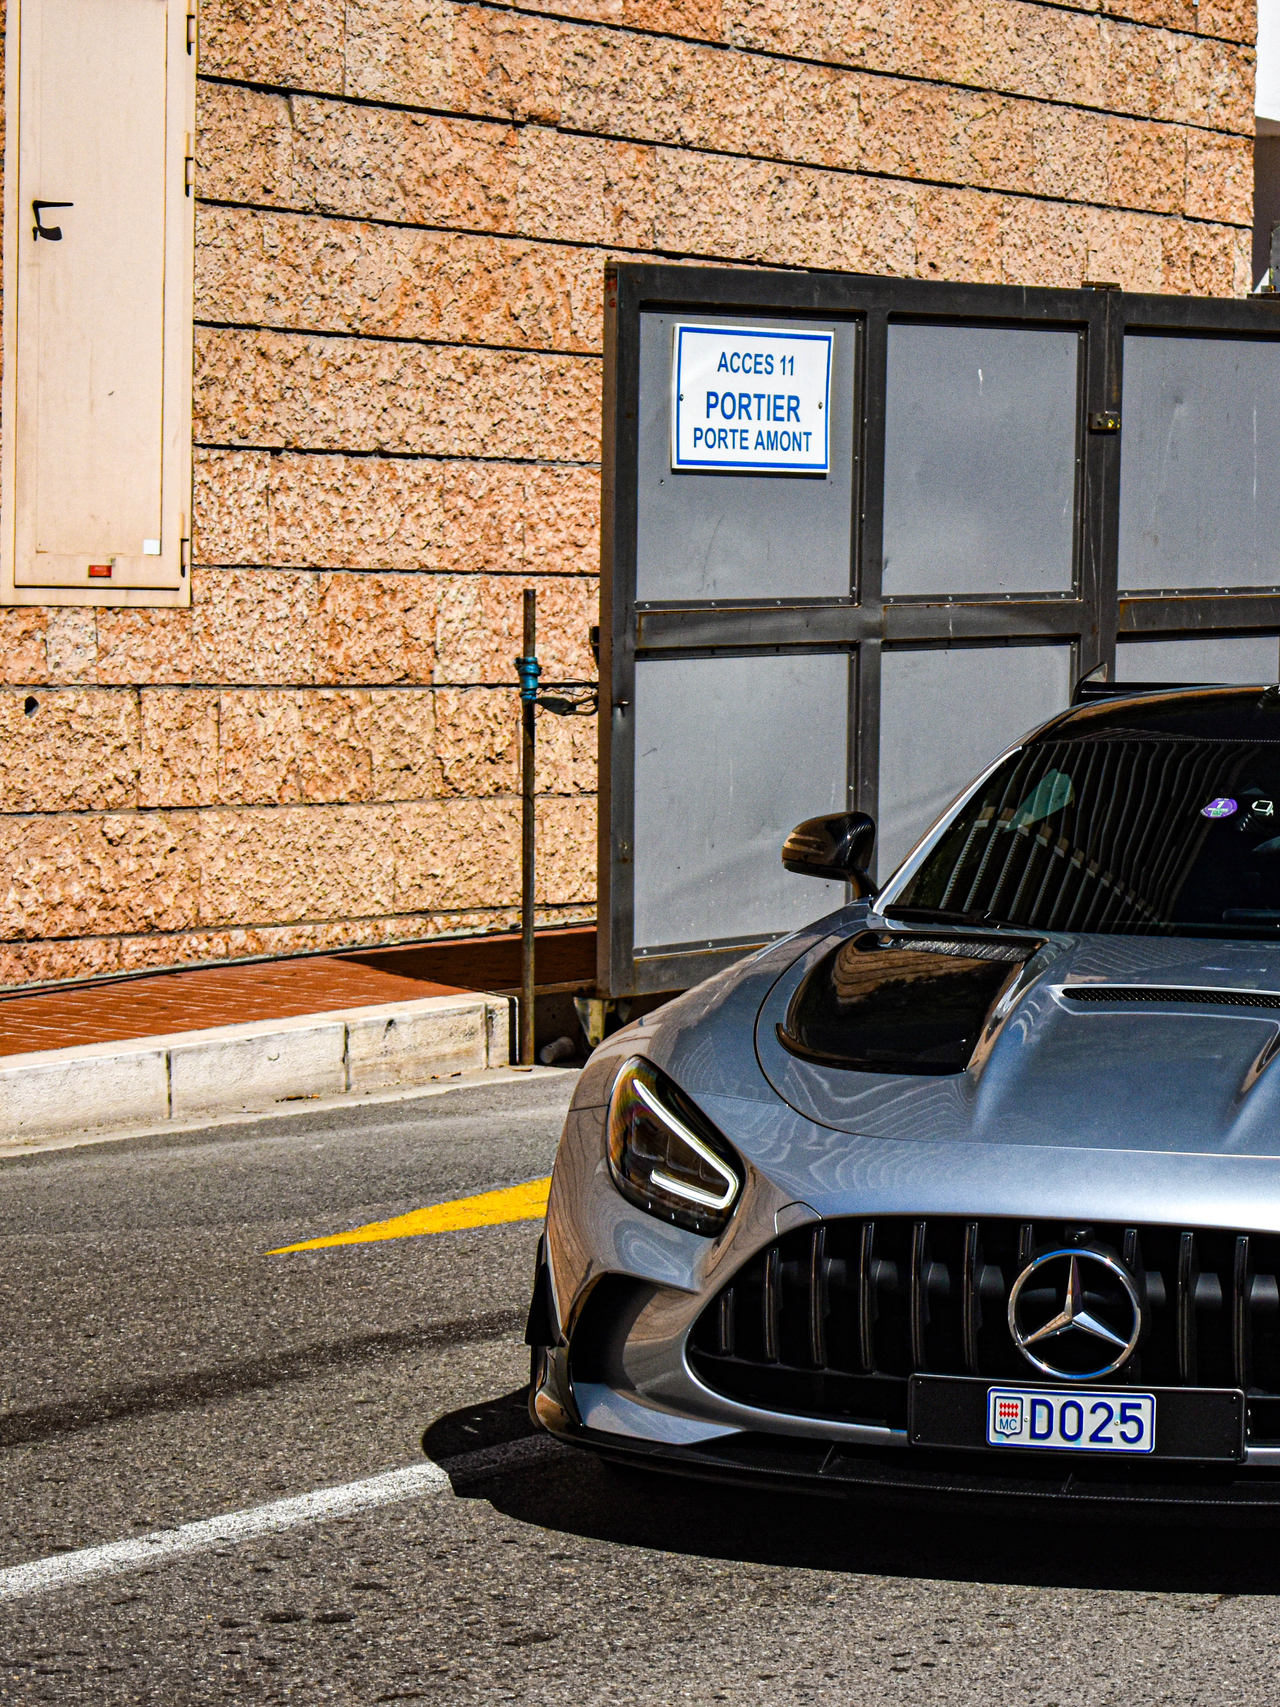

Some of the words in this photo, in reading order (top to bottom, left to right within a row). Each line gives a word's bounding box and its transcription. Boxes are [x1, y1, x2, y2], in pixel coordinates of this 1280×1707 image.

[717, 351, 774, 376] ACCES
[779, 354, 795, 376] 11
[705, 390, 801, 423] PORTIER
[693, 427, 750, 450] PORTE
[754, 429, 813, 452] AMONT
[999, 1418, 1017, 1431] MC
[1029, 1397, 1145, 1444] D025
